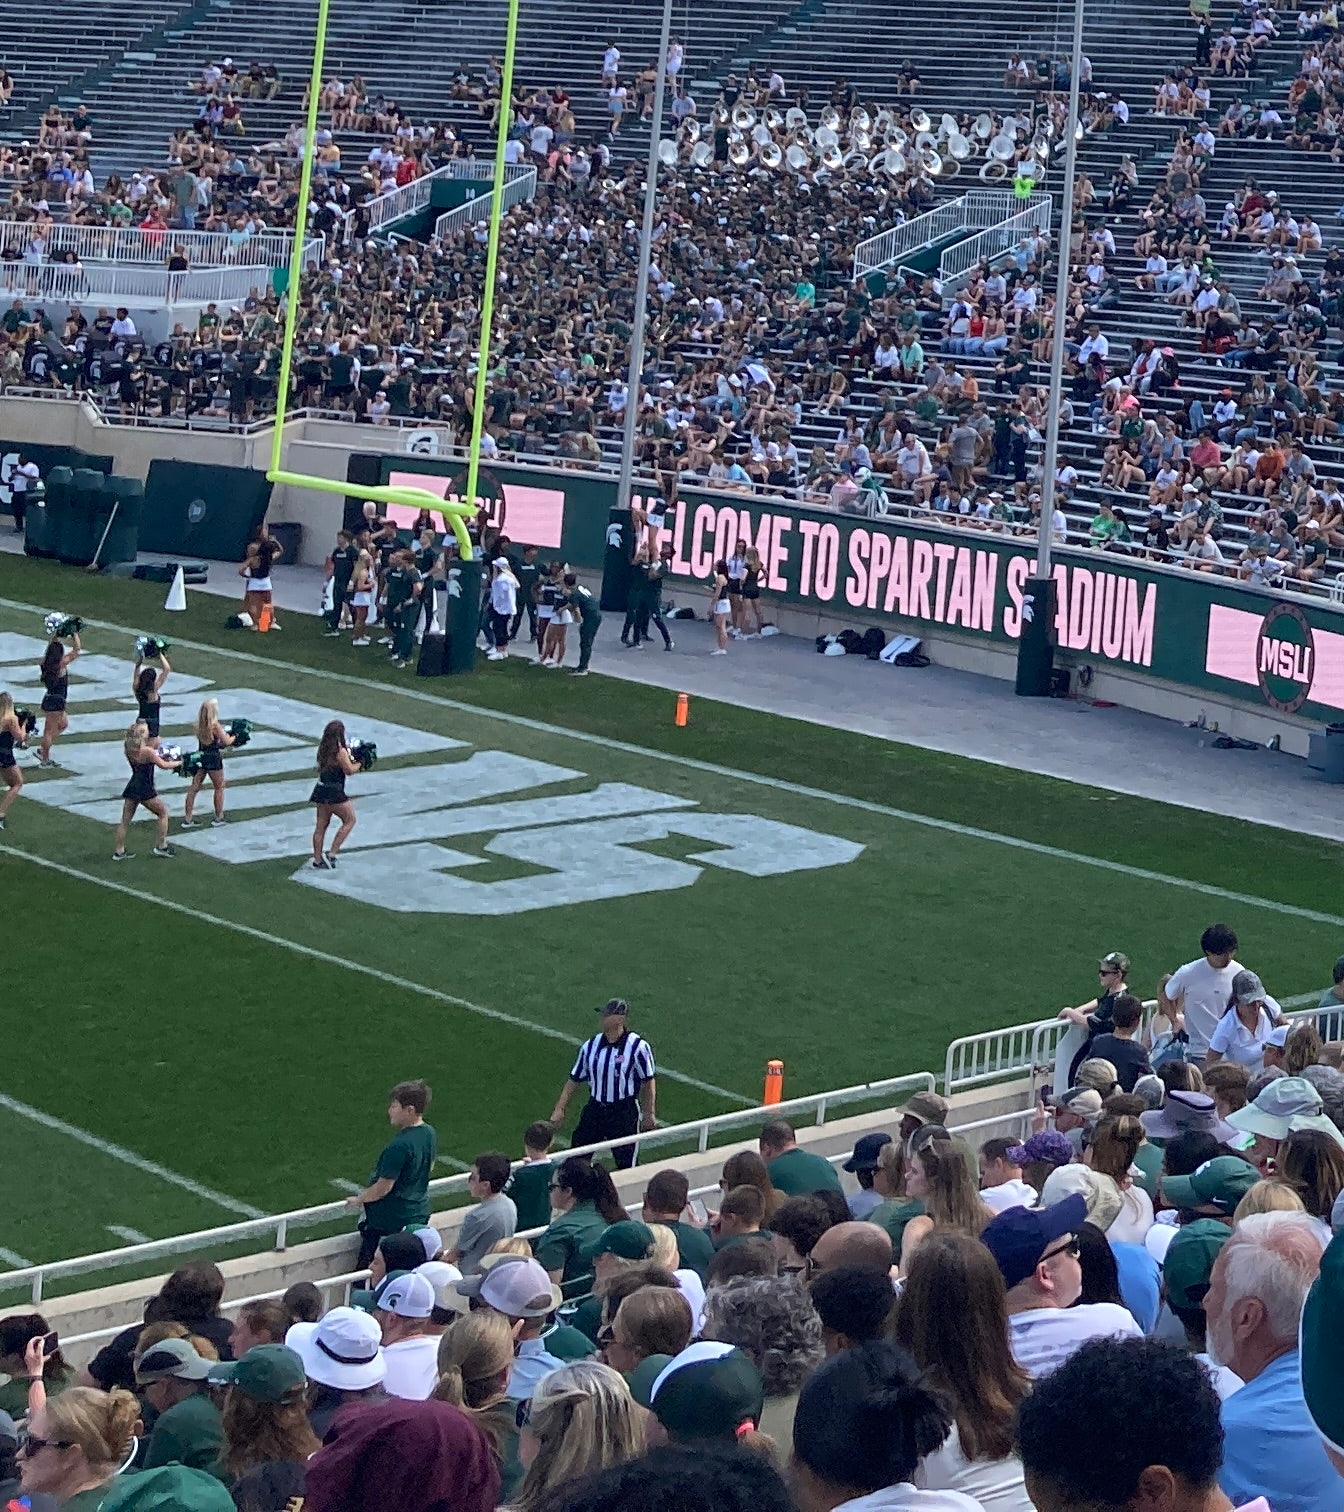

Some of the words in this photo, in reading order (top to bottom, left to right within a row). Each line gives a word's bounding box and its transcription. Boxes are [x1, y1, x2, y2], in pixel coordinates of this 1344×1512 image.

[799, 520, 840, 601] TO
[846, 528, 998, 632] SPARTAN
[1004, 555, 1157, 667] SADIUM
[1260, 636, 1311, 684] MSU
